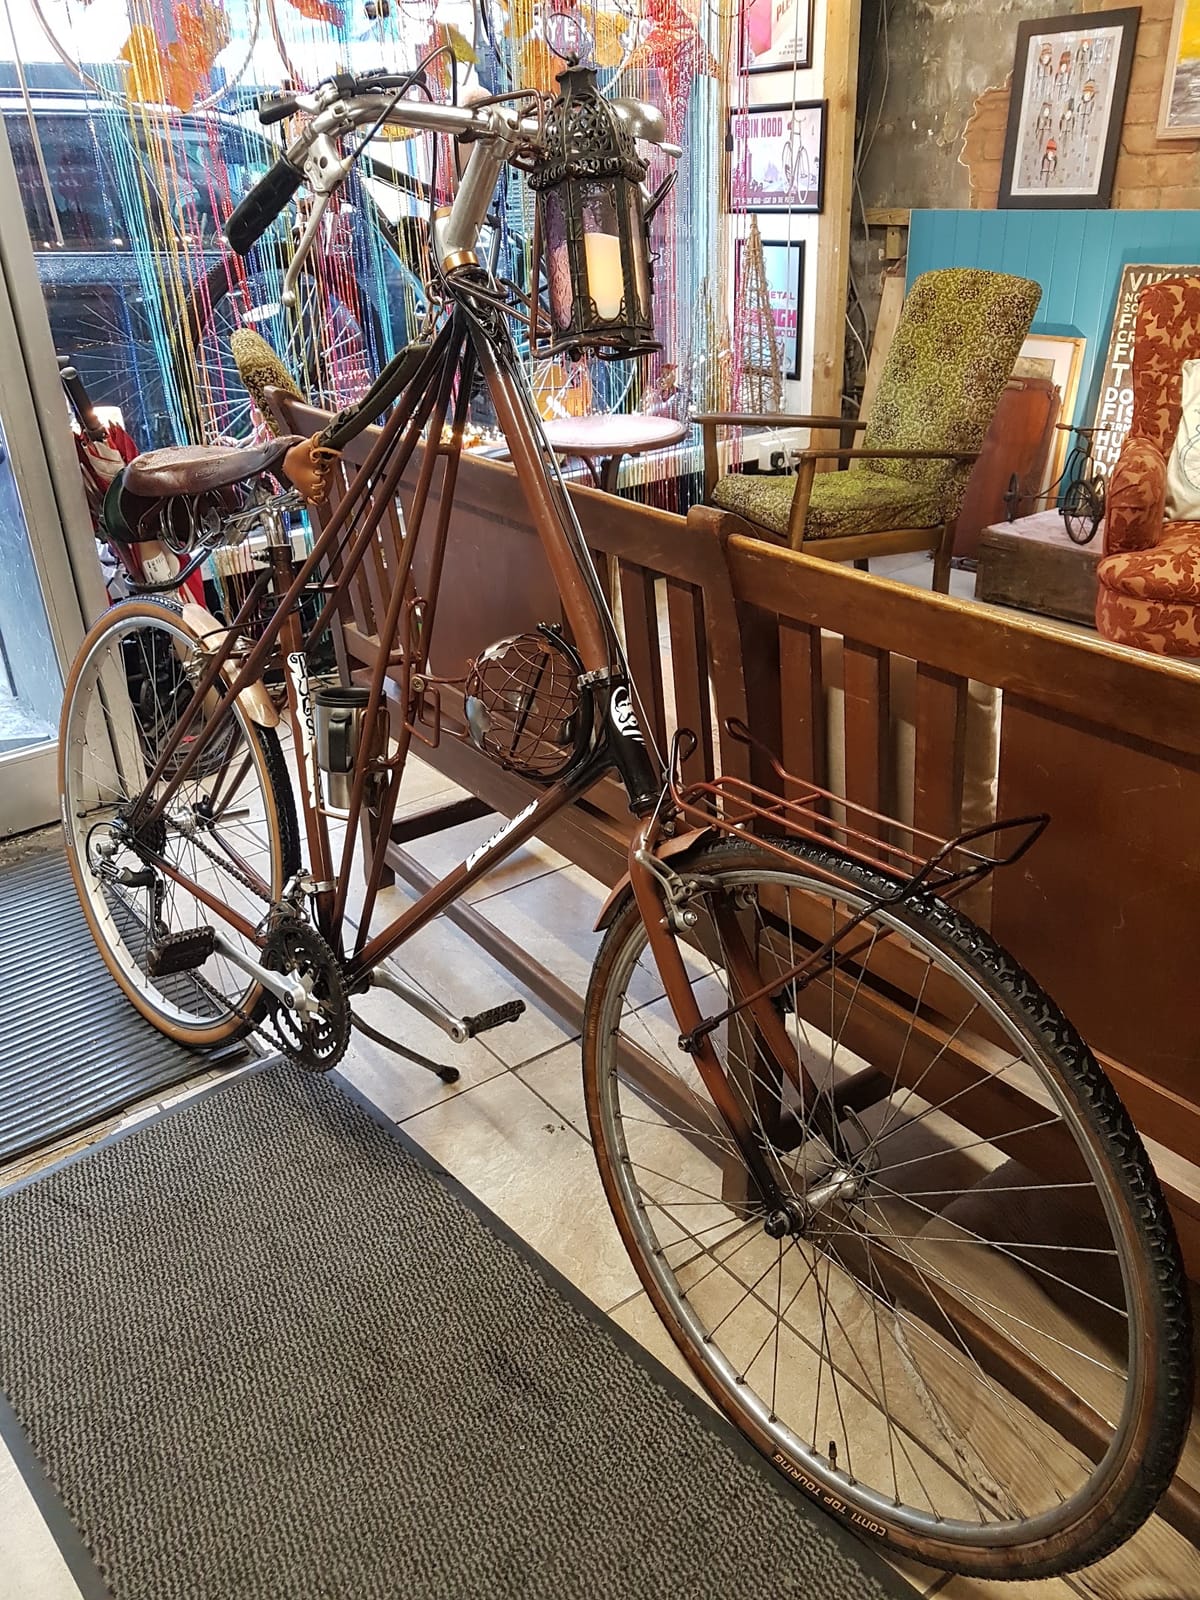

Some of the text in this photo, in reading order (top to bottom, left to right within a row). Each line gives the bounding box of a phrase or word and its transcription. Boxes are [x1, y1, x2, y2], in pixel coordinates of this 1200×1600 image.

[760, 116, 783, 138] HOOD
[772, 1453, 888, 1537] CONTI TOP TOURING
